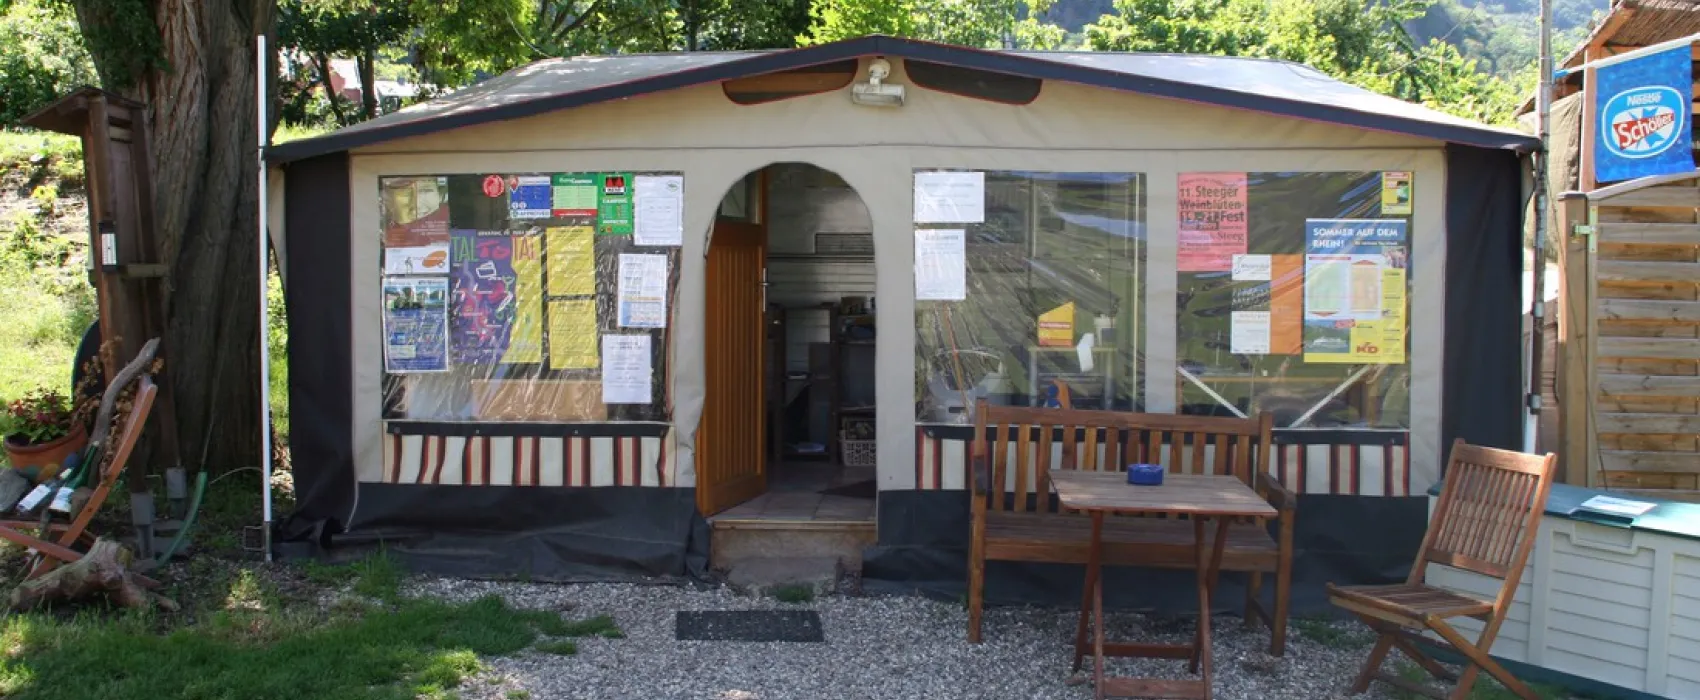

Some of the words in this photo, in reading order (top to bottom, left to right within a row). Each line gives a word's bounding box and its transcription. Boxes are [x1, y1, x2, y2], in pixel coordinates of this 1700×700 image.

[1617, 115, 1672, 147] Schöller
[1180, 188, 1194, 197] 11.
[1196, 186, 1239, 198] Steeger
[1220, 210, 1245, 222] Fest
[1312, 228, 1354, 236] SOMMER
[1356, 228, 1374, 236] AUF
[1377, 228, 1398, 237] DEM
[451, 236, 480, 262] TAL
[1312, 239, 1344, 248] RHEIN!
